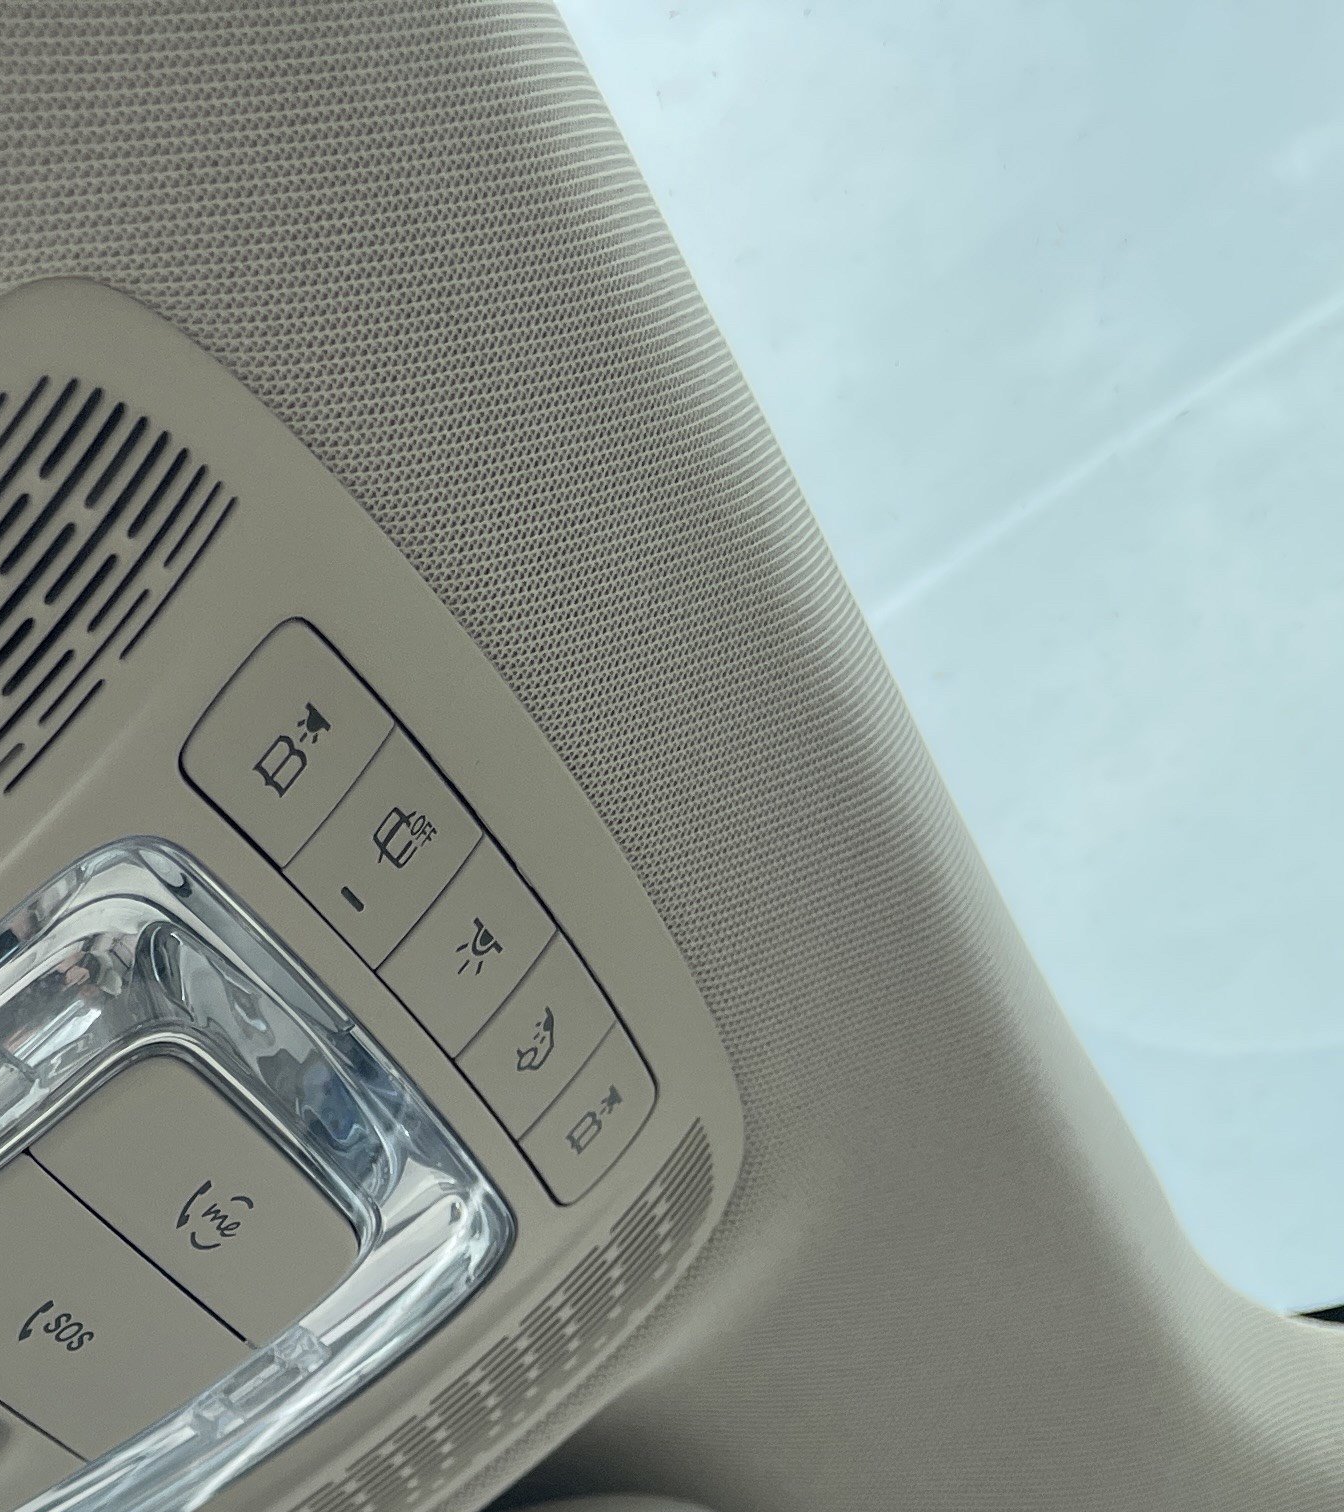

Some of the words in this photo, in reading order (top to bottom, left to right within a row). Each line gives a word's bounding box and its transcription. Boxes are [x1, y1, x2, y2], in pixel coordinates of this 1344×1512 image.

[410, 814, 437, 847] OFF
[201, 1203, 241, 1237] me
[43, 1312, 95, 1352] SOS
